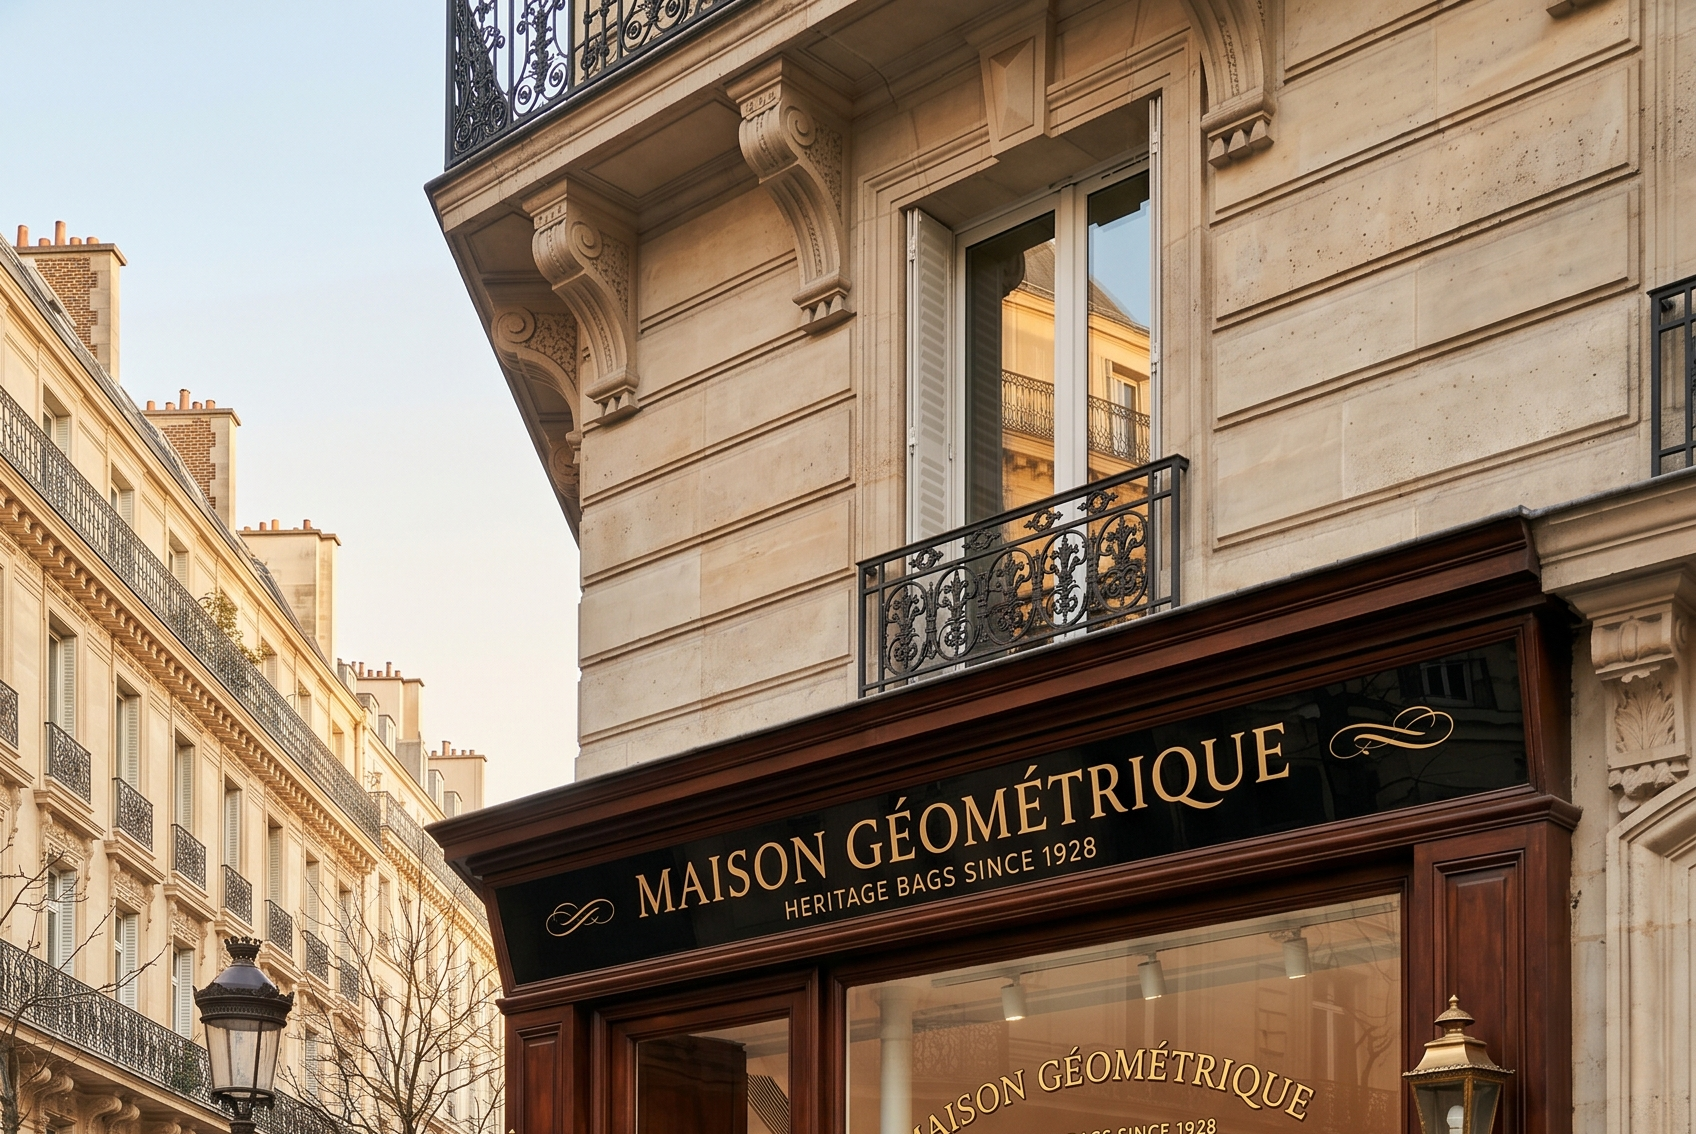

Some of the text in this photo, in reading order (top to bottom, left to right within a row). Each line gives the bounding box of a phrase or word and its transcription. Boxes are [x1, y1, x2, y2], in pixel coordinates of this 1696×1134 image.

[636, 722, 1290, 918] MAISON GÉOMÉTRIQUE
[785, 836, 1097, 920] HERITAGE BAGS SINCE 1928
[1037, 1040, 1315, 1120] GÉOMÉTRIQUE
